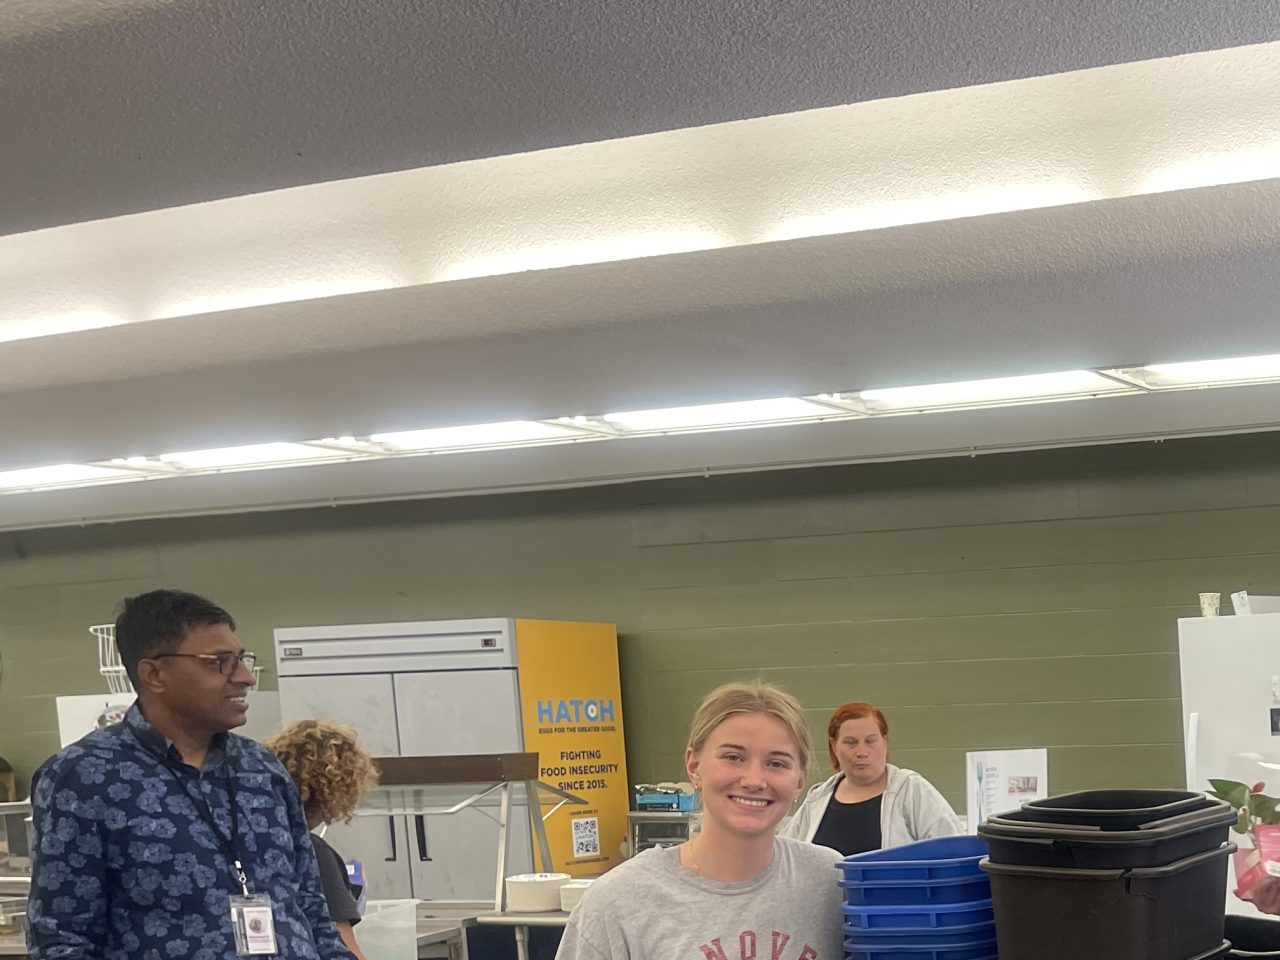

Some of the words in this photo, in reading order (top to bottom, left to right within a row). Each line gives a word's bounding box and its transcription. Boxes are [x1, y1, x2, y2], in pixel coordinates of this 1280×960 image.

[537, 699, 615, 723] HATCH
[560, 749, 602, 761] FIGHTING
[540, 766, 567, 777] FOOD
[568, 763, 618, 776] INSECURITY
[558, 780, 585, 792] SINCE
[586, 779, 608, 789] 2015.
